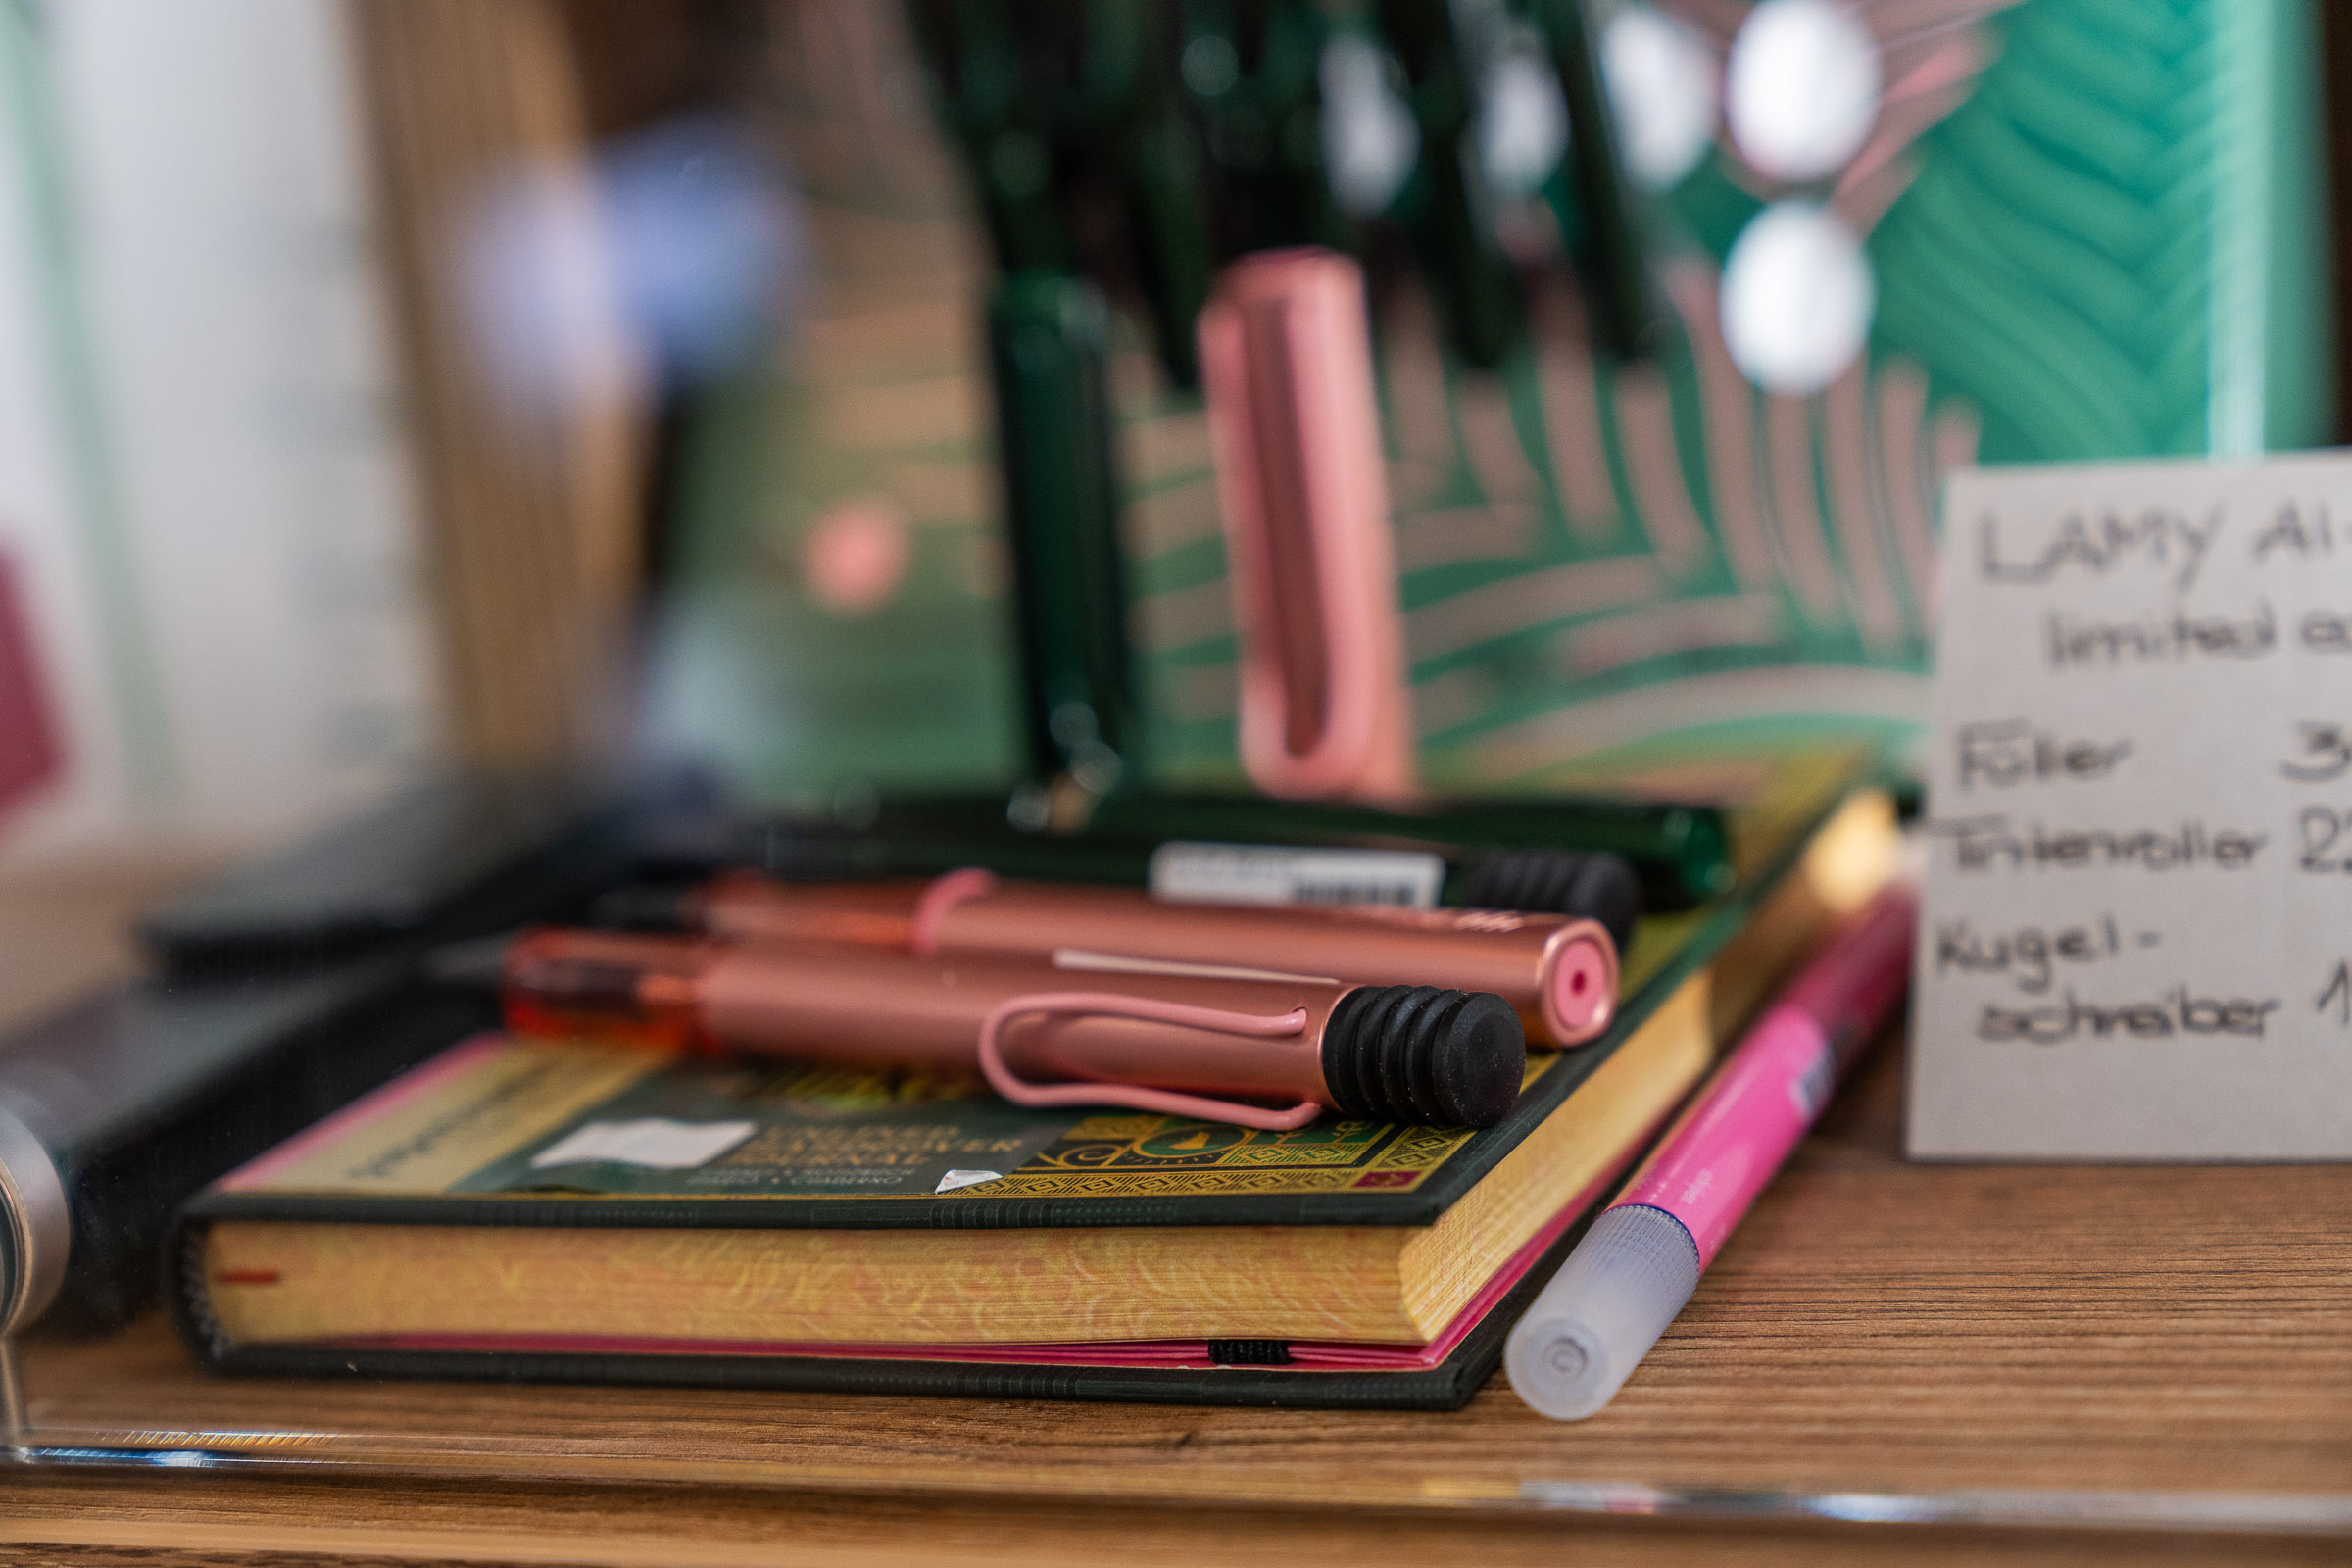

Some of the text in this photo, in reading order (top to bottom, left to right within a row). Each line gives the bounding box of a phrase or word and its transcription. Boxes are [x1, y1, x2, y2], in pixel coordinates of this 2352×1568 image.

[1980, 501, 2227, 591] LAMY
[2046, 598, 2278, 668] limited
[1936, 914, 2160, 995] Kugel-
[1976, 983, 2281, 1045] schreiber
